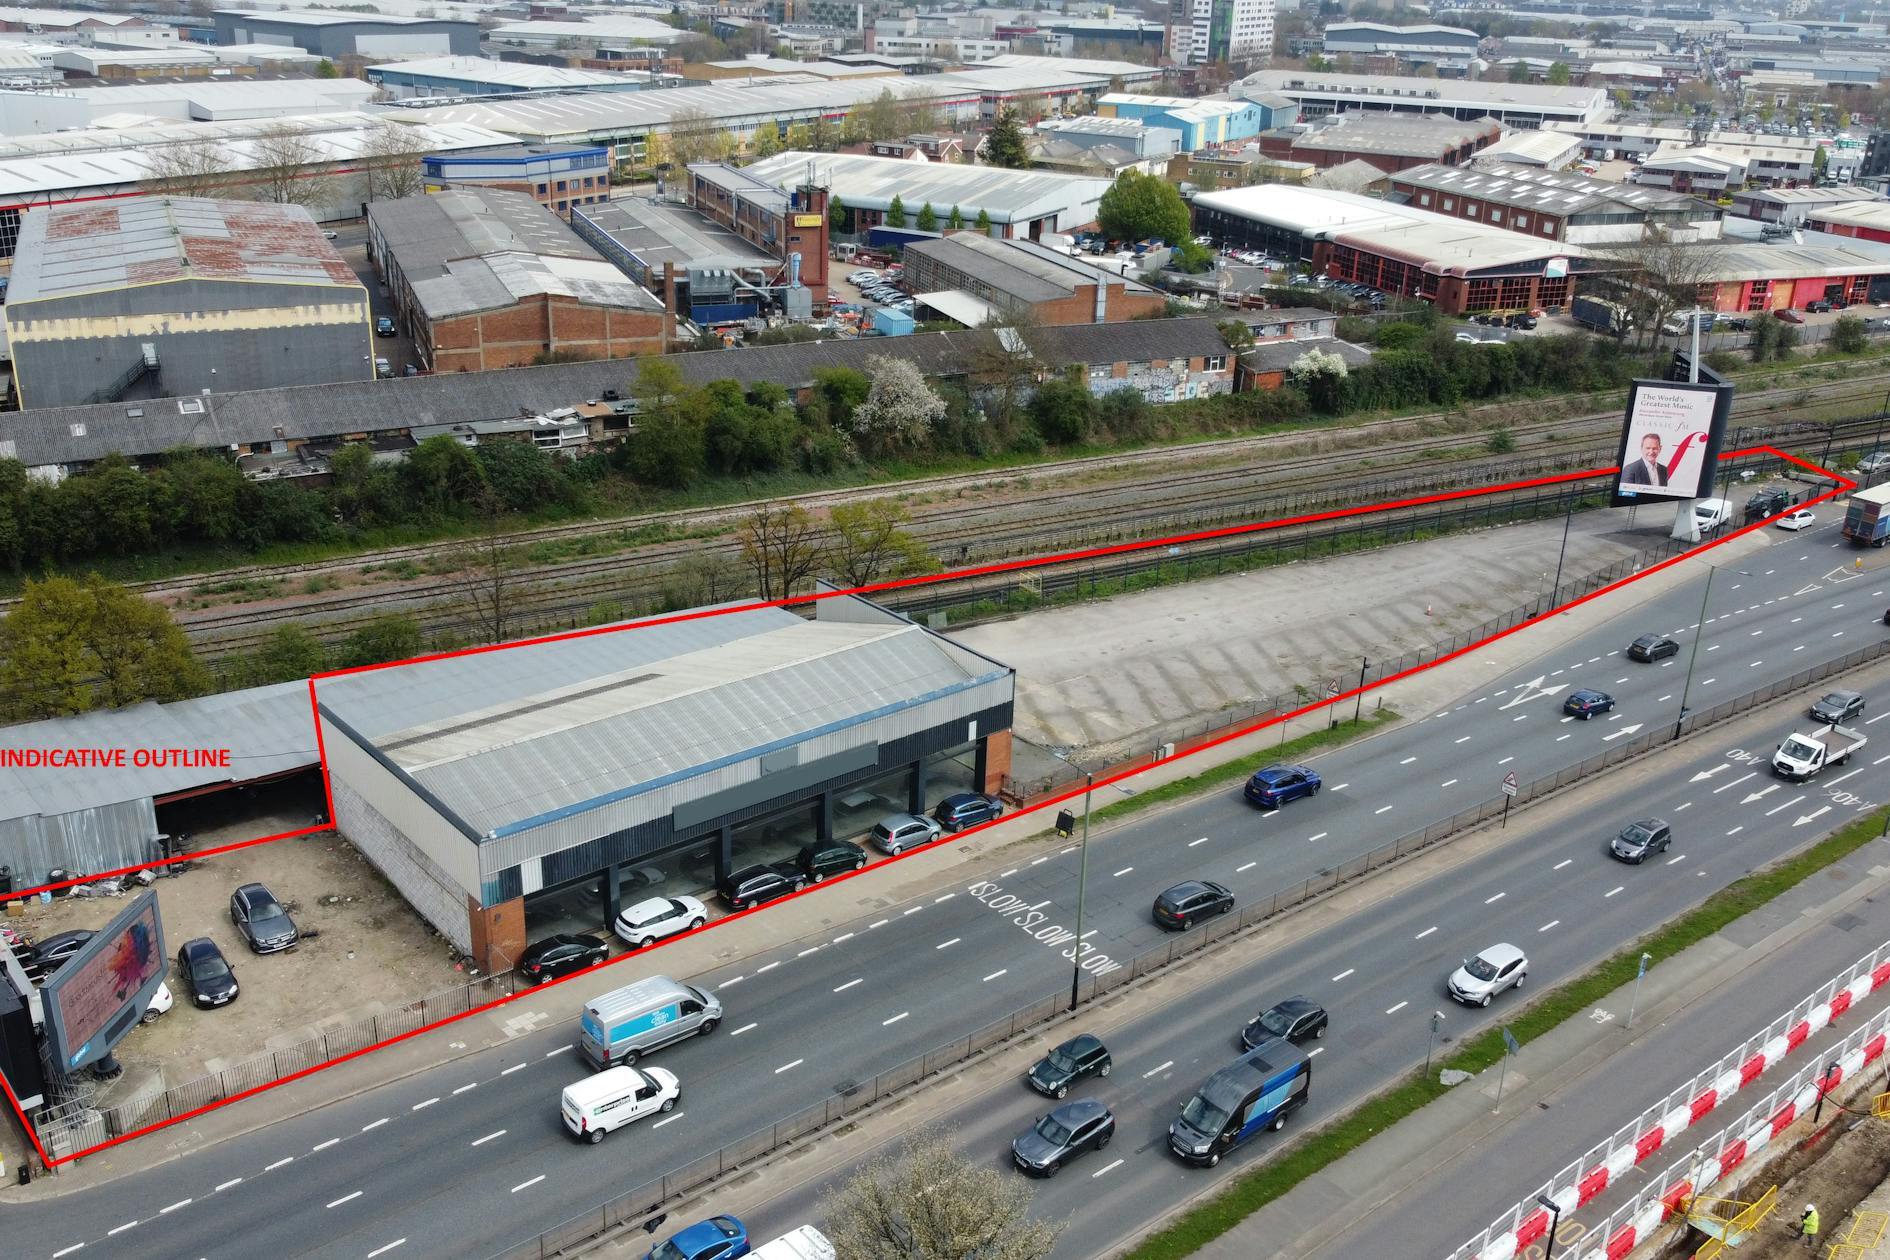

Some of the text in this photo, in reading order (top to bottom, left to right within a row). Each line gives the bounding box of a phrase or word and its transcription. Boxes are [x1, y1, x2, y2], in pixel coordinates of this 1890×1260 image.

[1640, 393, 1684, 403] The World's
[1640, 400, 1694, 410] Greatest Music
[1725, 748, 1766, 766] A40
[970, 883, 1031, 917] SLOW
[1013, 911, 1077, 947] SLOW
[1062, 942, 1123, 977] SLOW
